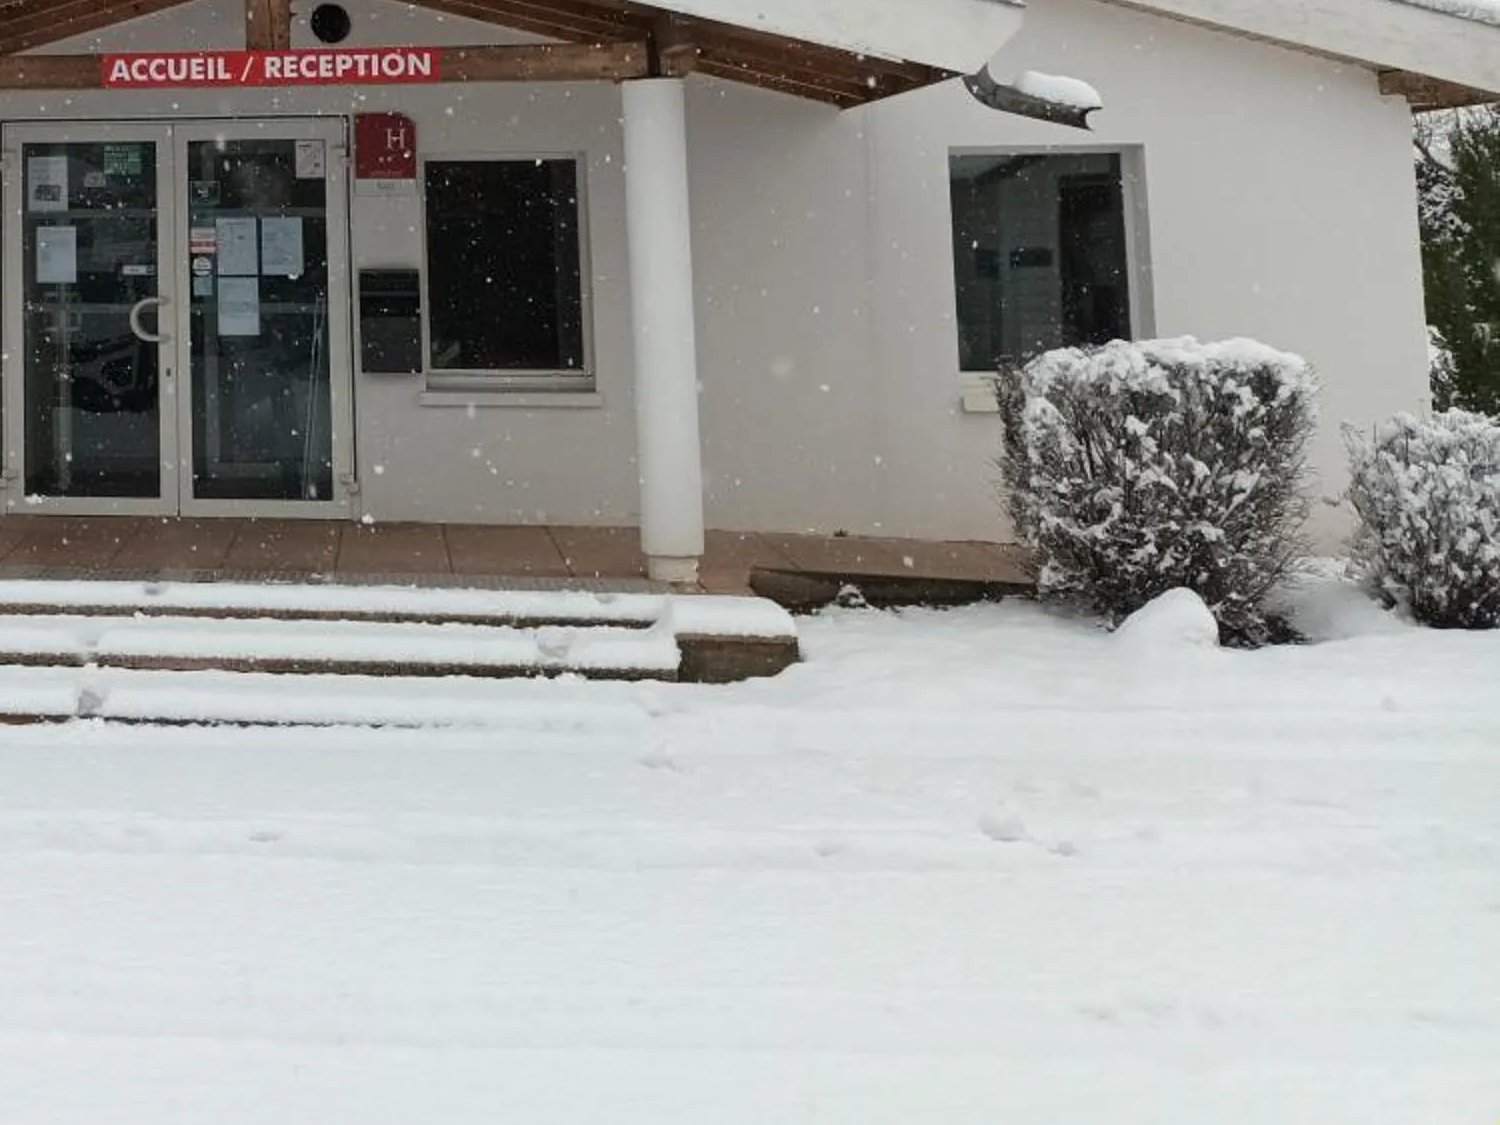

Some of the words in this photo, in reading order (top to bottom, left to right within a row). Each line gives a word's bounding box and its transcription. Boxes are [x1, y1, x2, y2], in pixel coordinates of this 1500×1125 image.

[109, 57, 232, 81] ACCUEIL
[264, 52, 431, 79] RECEPTION
[387, 128, 405, 149] H
